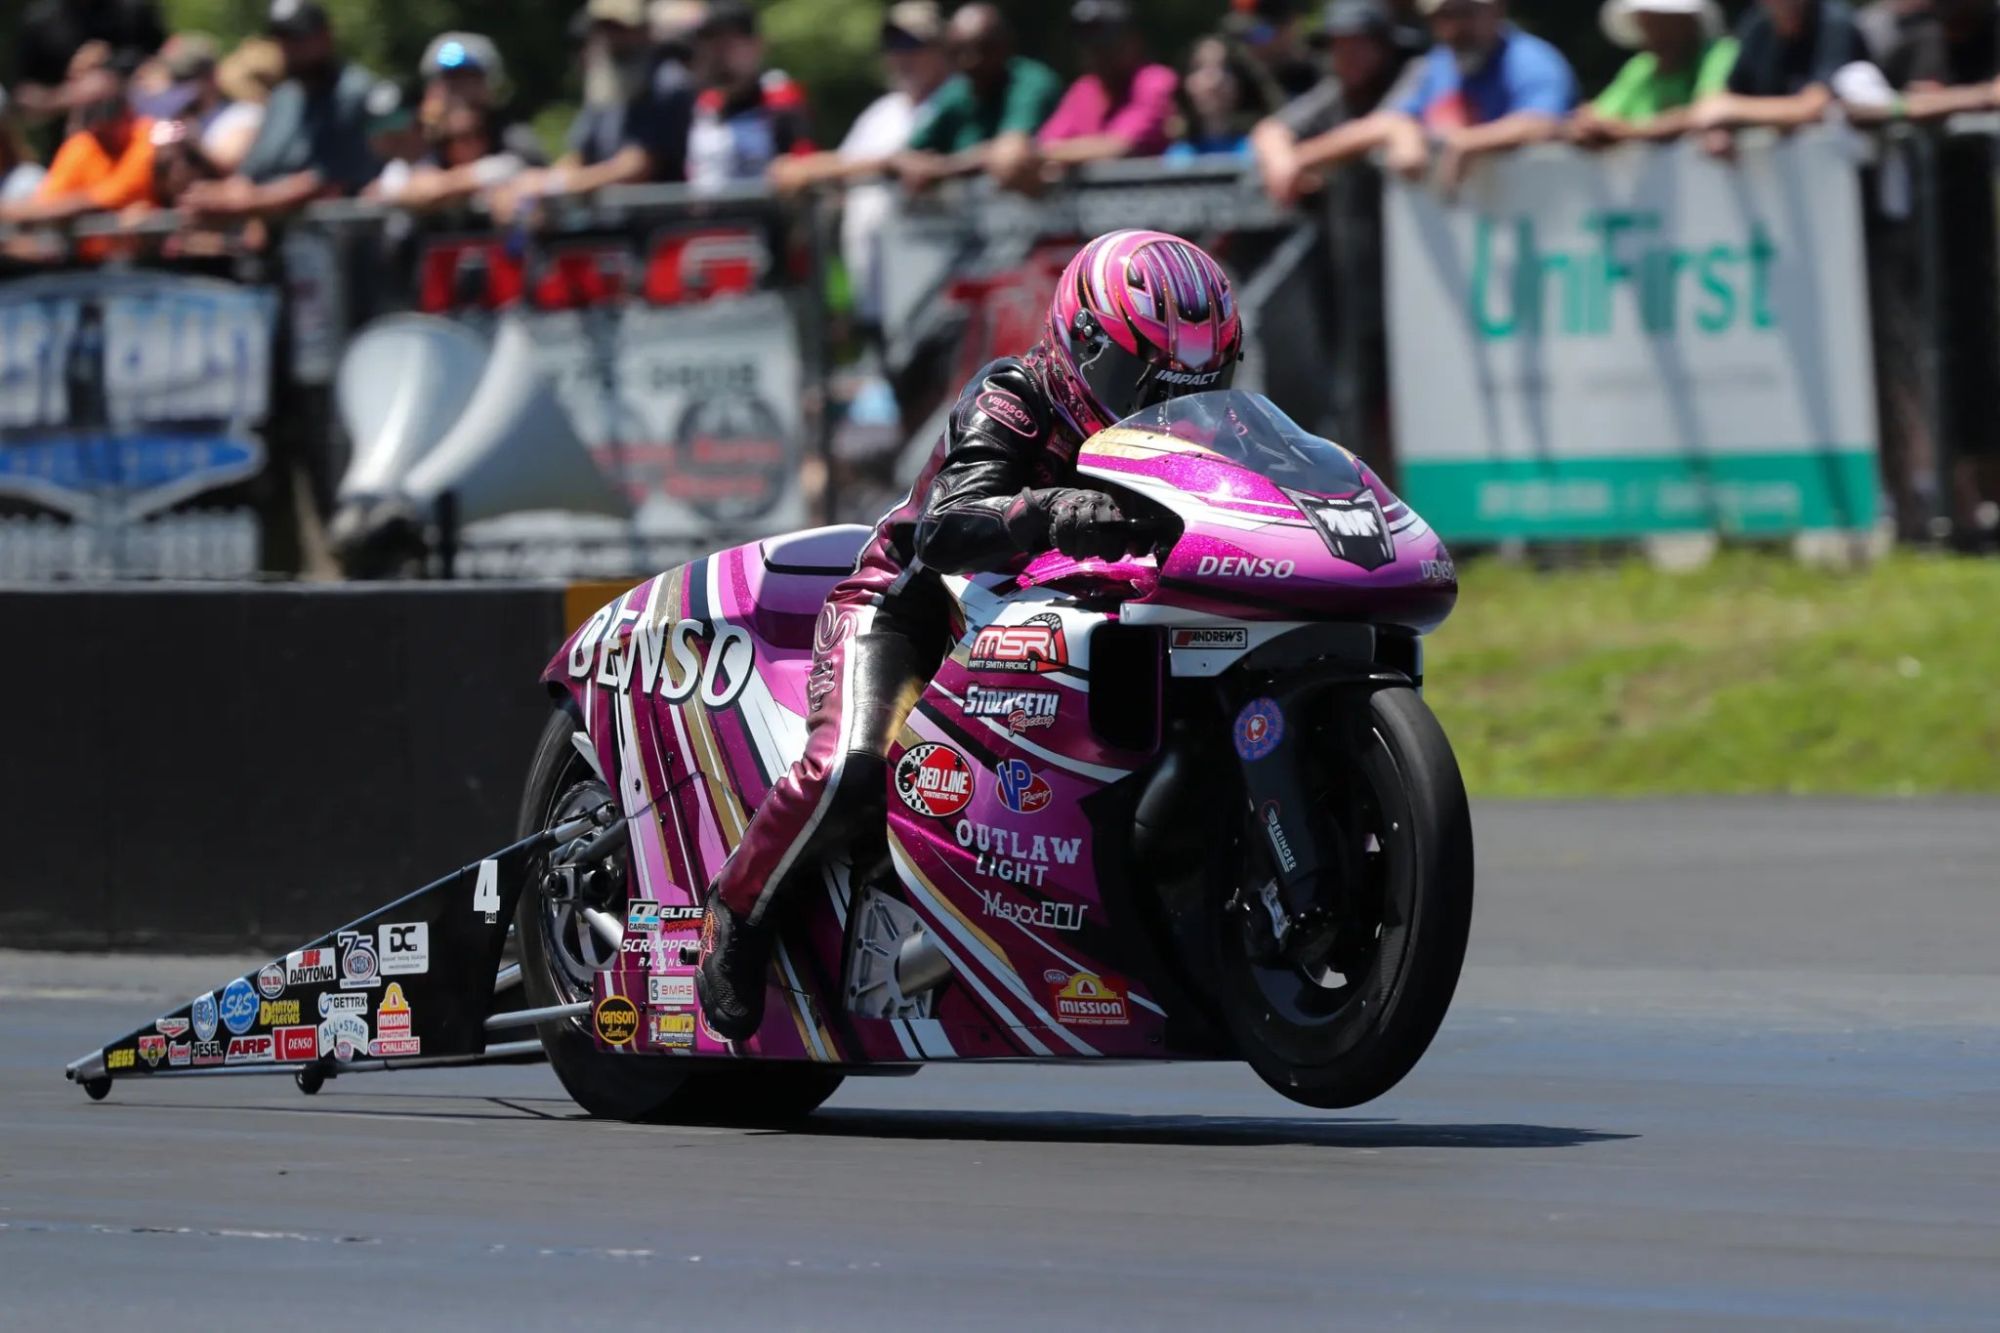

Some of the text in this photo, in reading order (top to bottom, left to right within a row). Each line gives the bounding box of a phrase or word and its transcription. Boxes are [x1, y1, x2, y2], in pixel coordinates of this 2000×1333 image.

[1472, 207, 1779, 340] UniFirst
[1154, 369, 1221, 386] IMPACT
[988, 395, 1032, 426] vanson
[1196, 555, 1295, 579] DENSO
[972, 628, 1050, 660] MSR
[567, 606, 755, 707] DENSO
[969, 660, 1029, 671] MATT SMITH RACING
[1008, 710, 1056, 737] Racing
[917, 766, 969, 794] RED LINE
[996, 759, 1033, 813] VP
[1022, 790, 1052, 807] Racing
[955, 819, 1082, 865] OUTLAW
[1268, 807, 1297, 872] BERINGER
[975, 853, 1049, 887] LIGHT
[473, 859, 500, 911] 4
[660, 907, 704, 919] ELITE
[982, 889, 1088, 931] MaxxECU
[290, 965, 334, 984] DAYTONA
[334, 996, 366, 1009] GETTRX
[599, 1010, 635, 1025] vanson
[193, 1042, 223, 1058] JESEL
[228, 1038, 272, 1055] ARP
[288, 1036, 313, 1050] DENSO
[382, 1040, 418, 1053] CHALLENGE
[108, 1049, 135, 1068] JEGS
